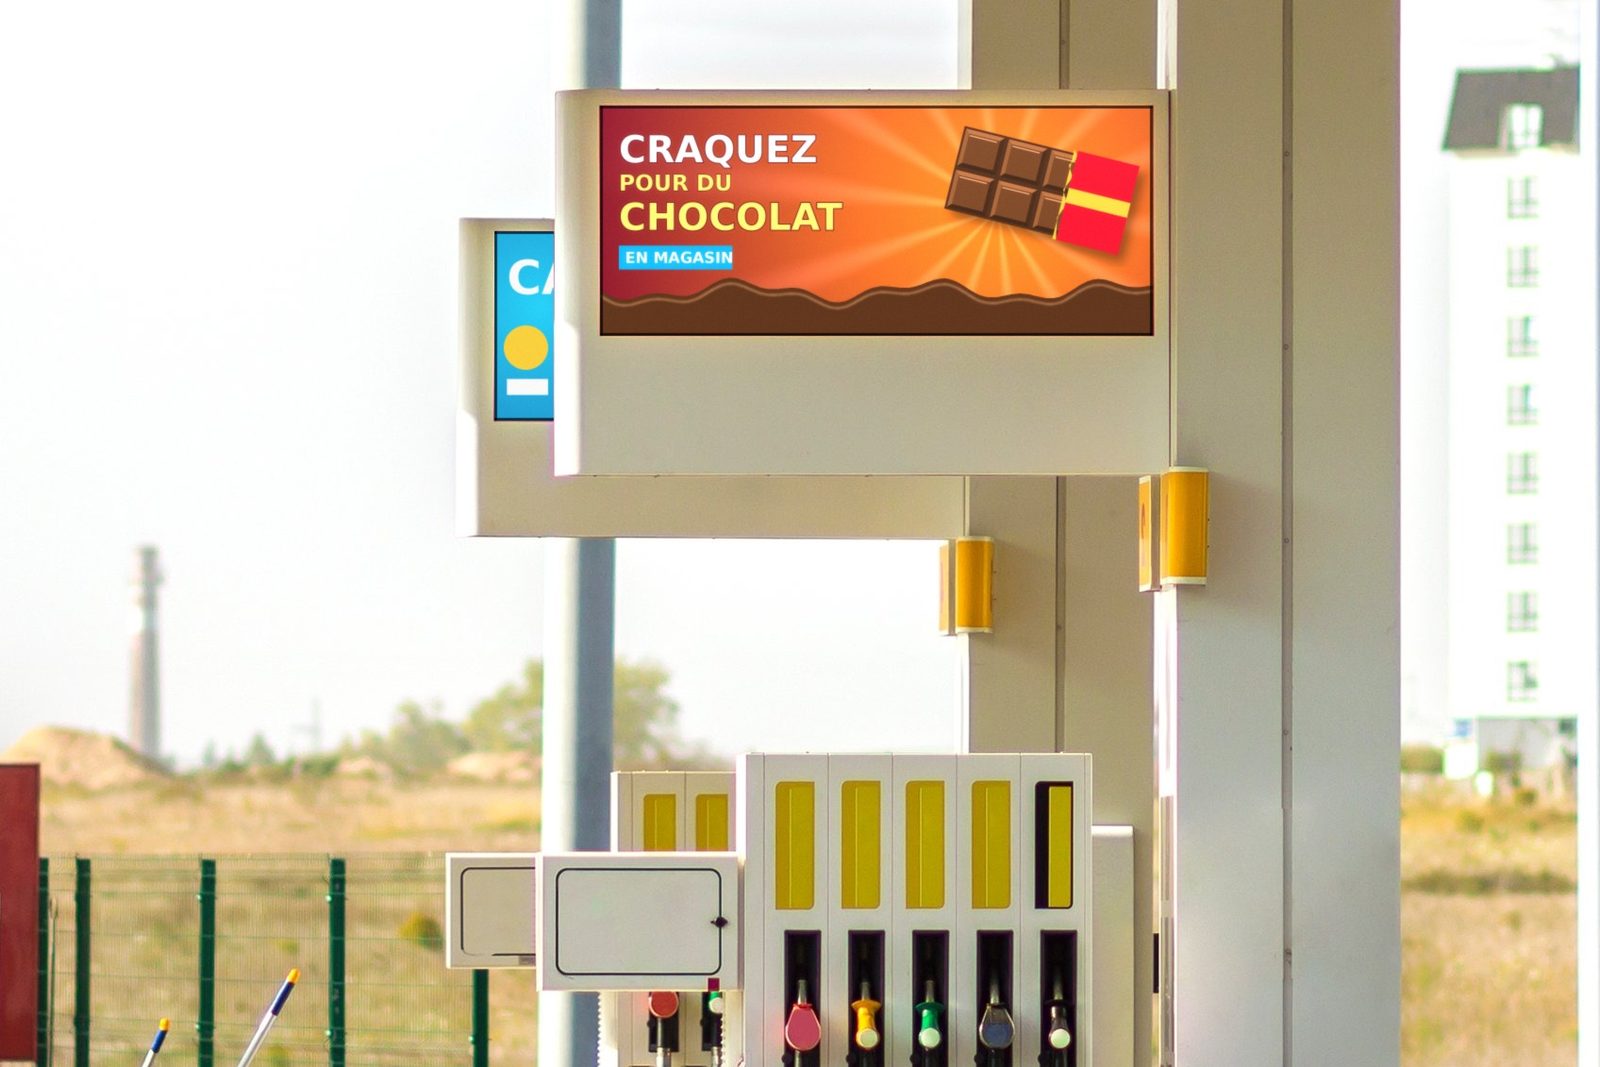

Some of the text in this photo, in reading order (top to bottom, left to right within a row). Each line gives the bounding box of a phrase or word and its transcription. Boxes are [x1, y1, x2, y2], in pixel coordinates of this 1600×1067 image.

[620, 134, 817, 168] CRAQUEZ
[620, 174, 731, 191] POUR DU
[620, 202, 843, 231] CHOCOLAT
[625, 251, 732, 264] EN MAGASIN
